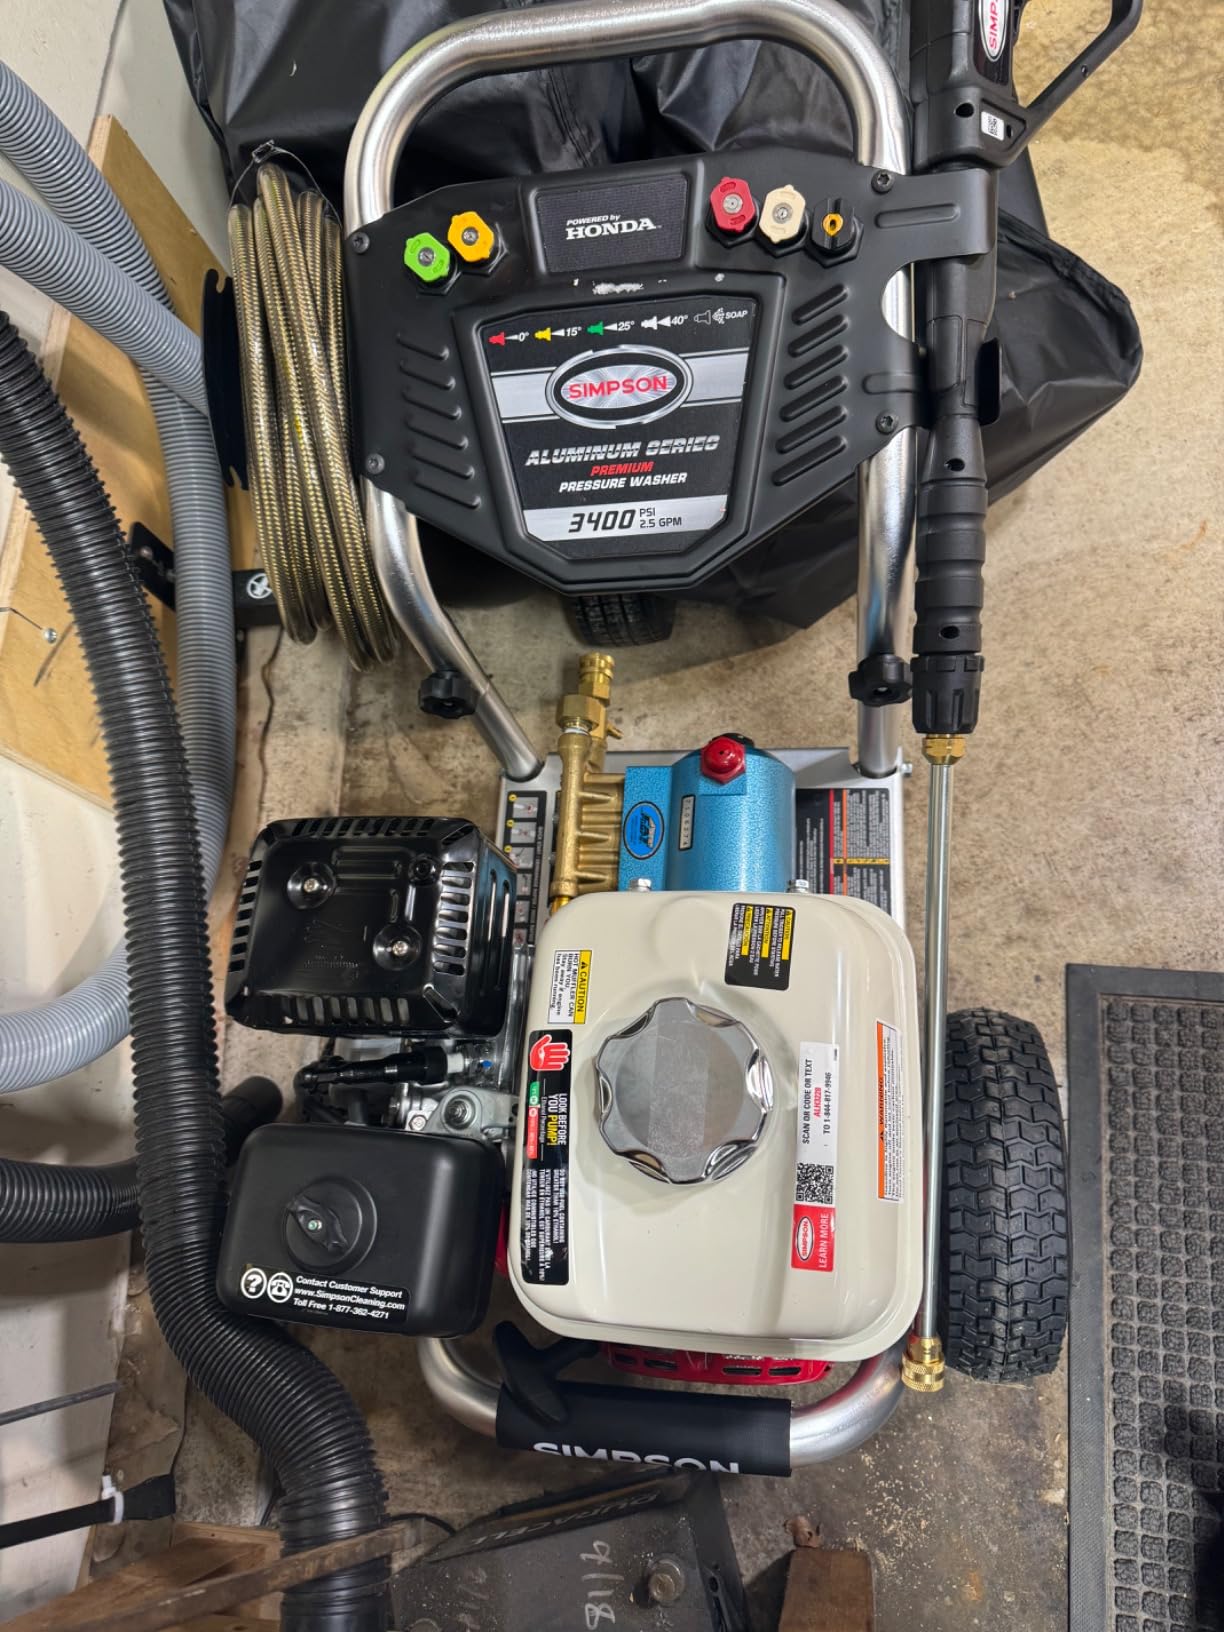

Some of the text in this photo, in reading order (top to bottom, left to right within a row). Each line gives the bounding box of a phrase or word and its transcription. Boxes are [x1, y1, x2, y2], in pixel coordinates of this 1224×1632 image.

[989, 0, 998, 49] SIMP
[566, 218, 656, 240] HONDA
[567, 215, 621, 226] POWERED by
[565, 326, 582, 336] 15°
[617, 321, 635, 331] 25°
[671, 315, 688, 325] 40°
[725, 310, 748, 320] SOAP
[568, 376, 668, 399] SIMPSON
[525, 435, 720, 466] ALUMINUM SERIES
[590, 461, 655, 476] PREMIUM
[559, 473, 688, 493] PRESSURE WASHER
[568, 508, 656, 533] 3400 PSI
[640, 517, 682, 528] 2.5 GPM
[577, 972, 587, 1012] CAUTION
[805, 1059, 813, 1076] TEXT
[804, 1078, 811, 1088] OR
[547, 1094, 558, 1146] YOU PUMP!
[558, 1093, 567, 1145] LOOK BEFORE
[823, 1125, 830, 1135] TO
[802, 1123, 810, 1144] SCAN
[818, 1213, 829, 1268] LEARN MORE
[296, 1276, 402, 1298] Contact Customer Support
[293, 1298, 389, 1319] Toll Free 1-877-362-4271
[294, 1288, 405, 1310] www.SimpsonCleaning.com
